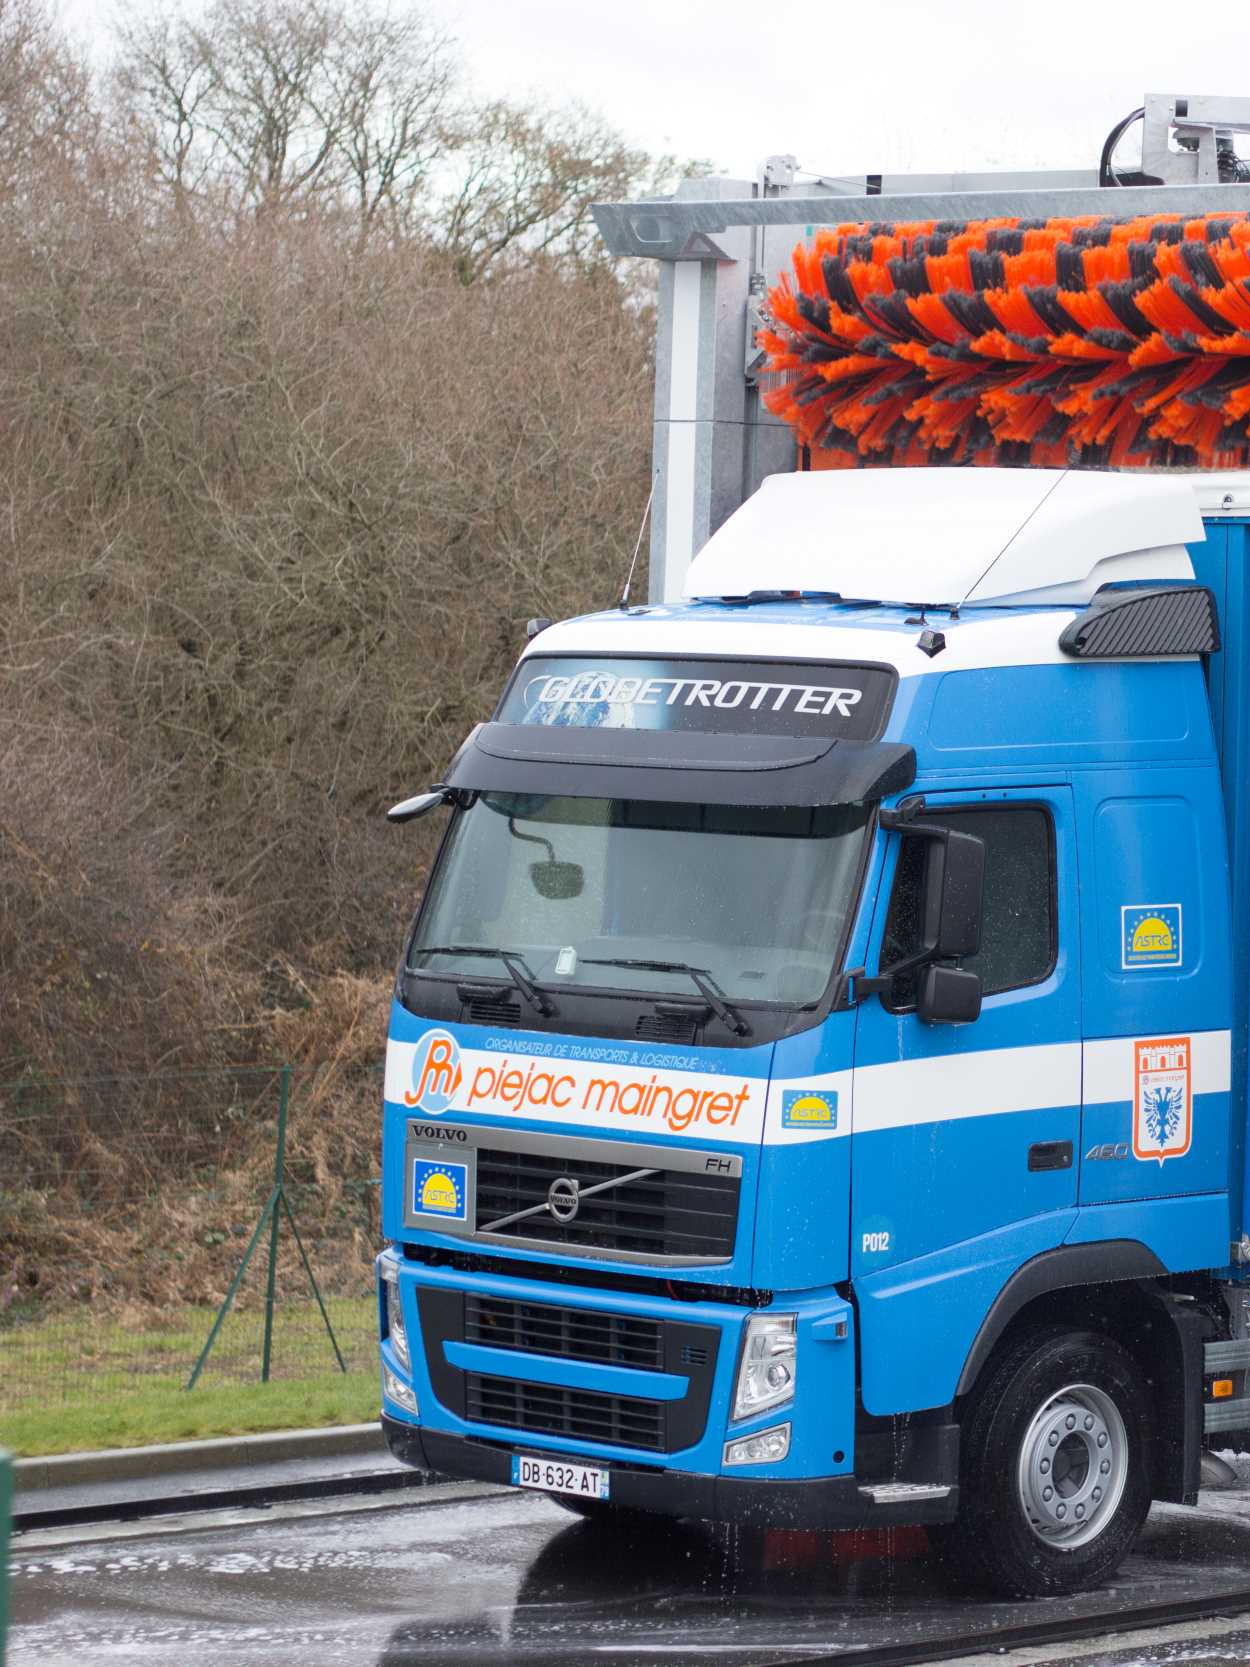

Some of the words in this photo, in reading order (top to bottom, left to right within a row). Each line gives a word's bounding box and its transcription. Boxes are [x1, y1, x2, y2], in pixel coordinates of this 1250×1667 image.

[536, 675, 863, 717] GLOBETROTTER
[485, 1037, 551, 1056] ORGANISATEUR
[552, 1044, 569, 1057] DE
[569, 1045, 630, 1063] TRANSPORTS
[630, 1052, 639, 1065] &
[640, 1053, 700, 1070] LOGISTIQUE
[466, 1059, 577, 1112] piejac
[582, 1075, 751, 1132] maingret
[412, 1124, 468, 1142] VOLVO
[705, 1158, 732, 1173] FH
